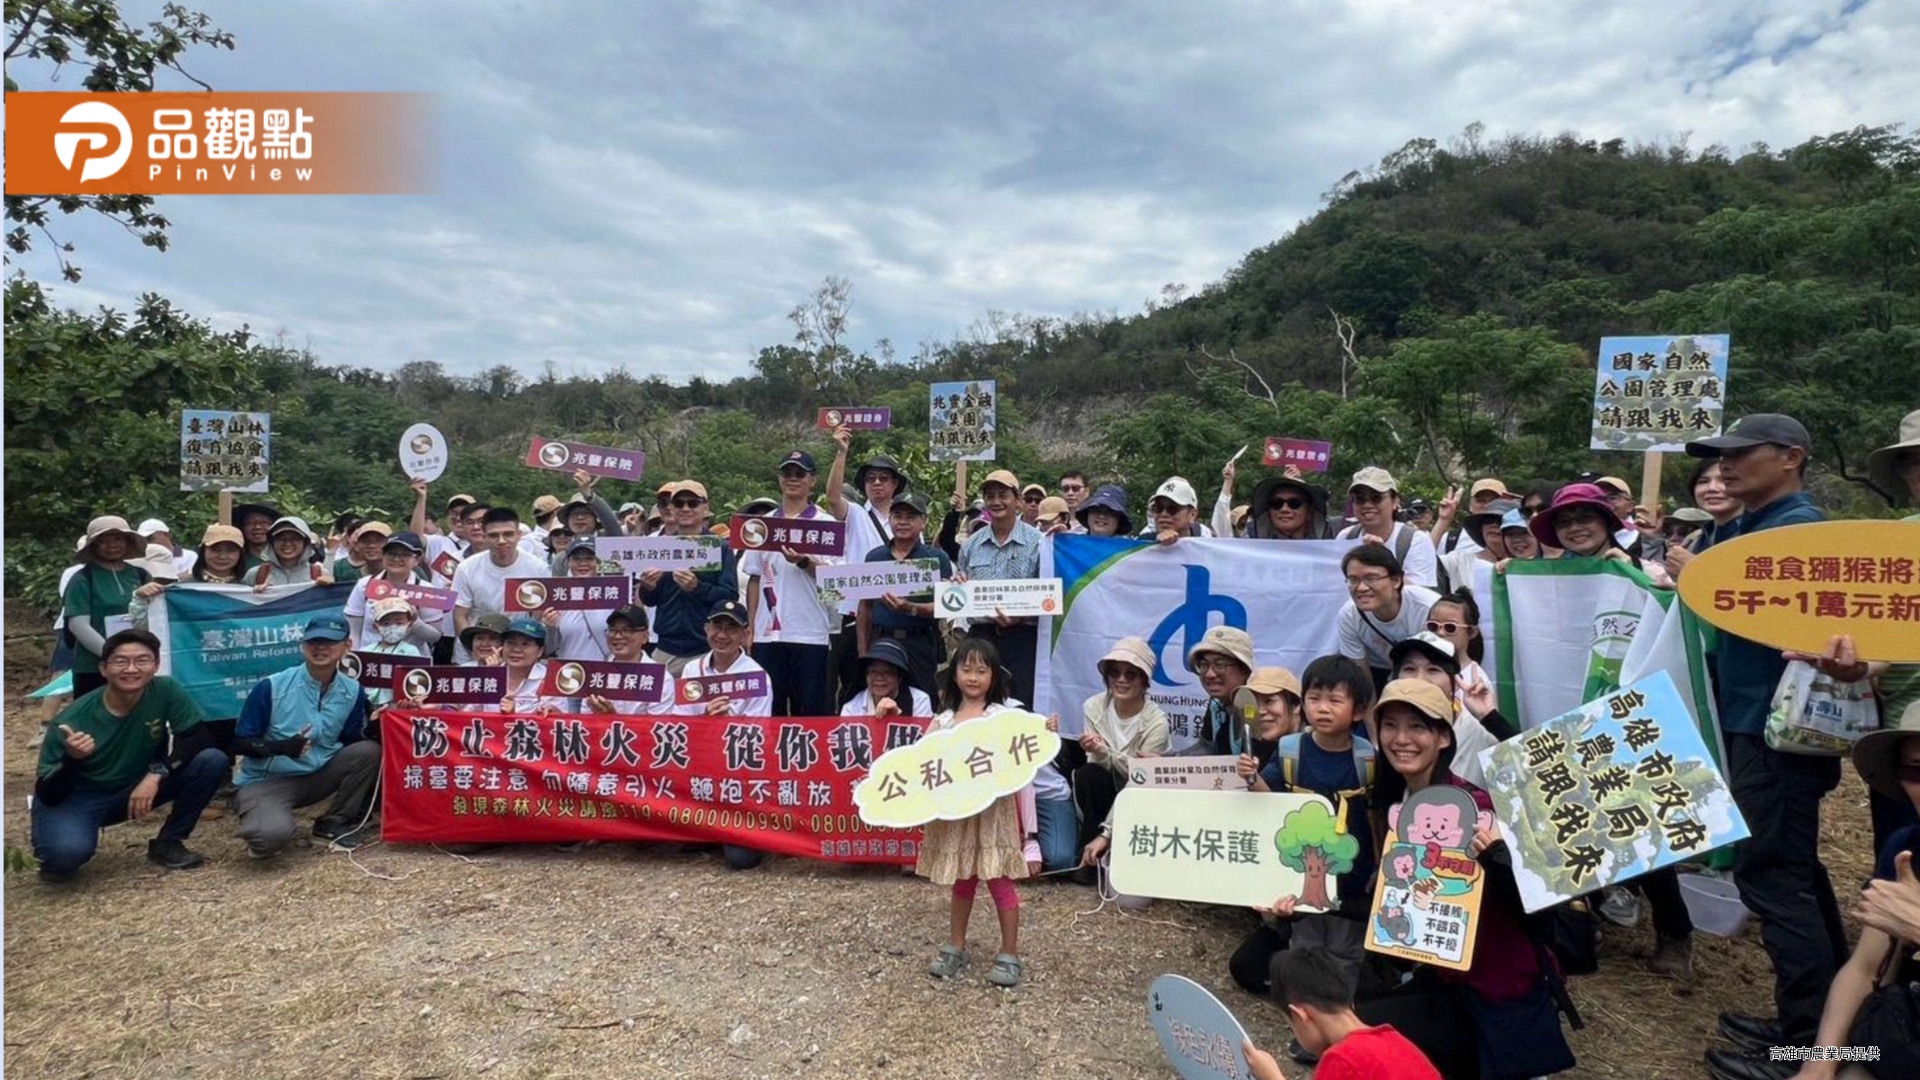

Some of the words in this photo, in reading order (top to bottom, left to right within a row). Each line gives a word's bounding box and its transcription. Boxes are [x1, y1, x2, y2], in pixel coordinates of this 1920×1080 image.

[1612, 352, 1711, 371] 國家自然
[1599, 379, 1721, 398] 公園管理處
[933, 392, 992, 409] 兆豐金融
[187, 417, 266, 436] 臺灣山林
[949, 411, 976, 427] 集團
[1600, 406, 1715, 430] 請跟我來
[186, 439, 264, 456] 復育協會
[933, 430, 991, 446] 請跟我來
[186, 460, 263, 477] 請跟我來
[572, 452, 633, 471] 兆豐保險
[773, 527, 836, 545] 兆豐保險
[610, 549, 708, 561] 高雄市政府農業局
[1745, 556, 1920, 584] 餵食獼猴將
[824, 571, 933, 590] 國家自然公園管理處
[552, 587, 619, 600] 兆豐保險
[201, 623, 304, 651] 臺灣山林
[201, 652, 247, 663] Taiwan
[436, 677, 498, 693] 兆豐保險
[589, 672, 654, 691] 兆豐保險
[708, 679, 760, 696] 兆豐保險
[411, 716, 690, 768] 防止森林火災
[878, 732, 1041, 802] 公私合作
[1607, 689, 1708, 852] 高雄市政府
[404, 765, 529, 791] 掃墓要注意
[542, 769, 676, 799] 勿隨意引火
[689, 776, 831, 806] 鞭炮不亂放
[1572, 732, 1650, 839] 農業局
[1524, 729, 1606, 887] 請跟我來
[821, 840, 924, 857] 高雄市政府農
[1129, 824, 1260, 865] 樹木保護
[1428, 901, 1463, 918] 不接觸
